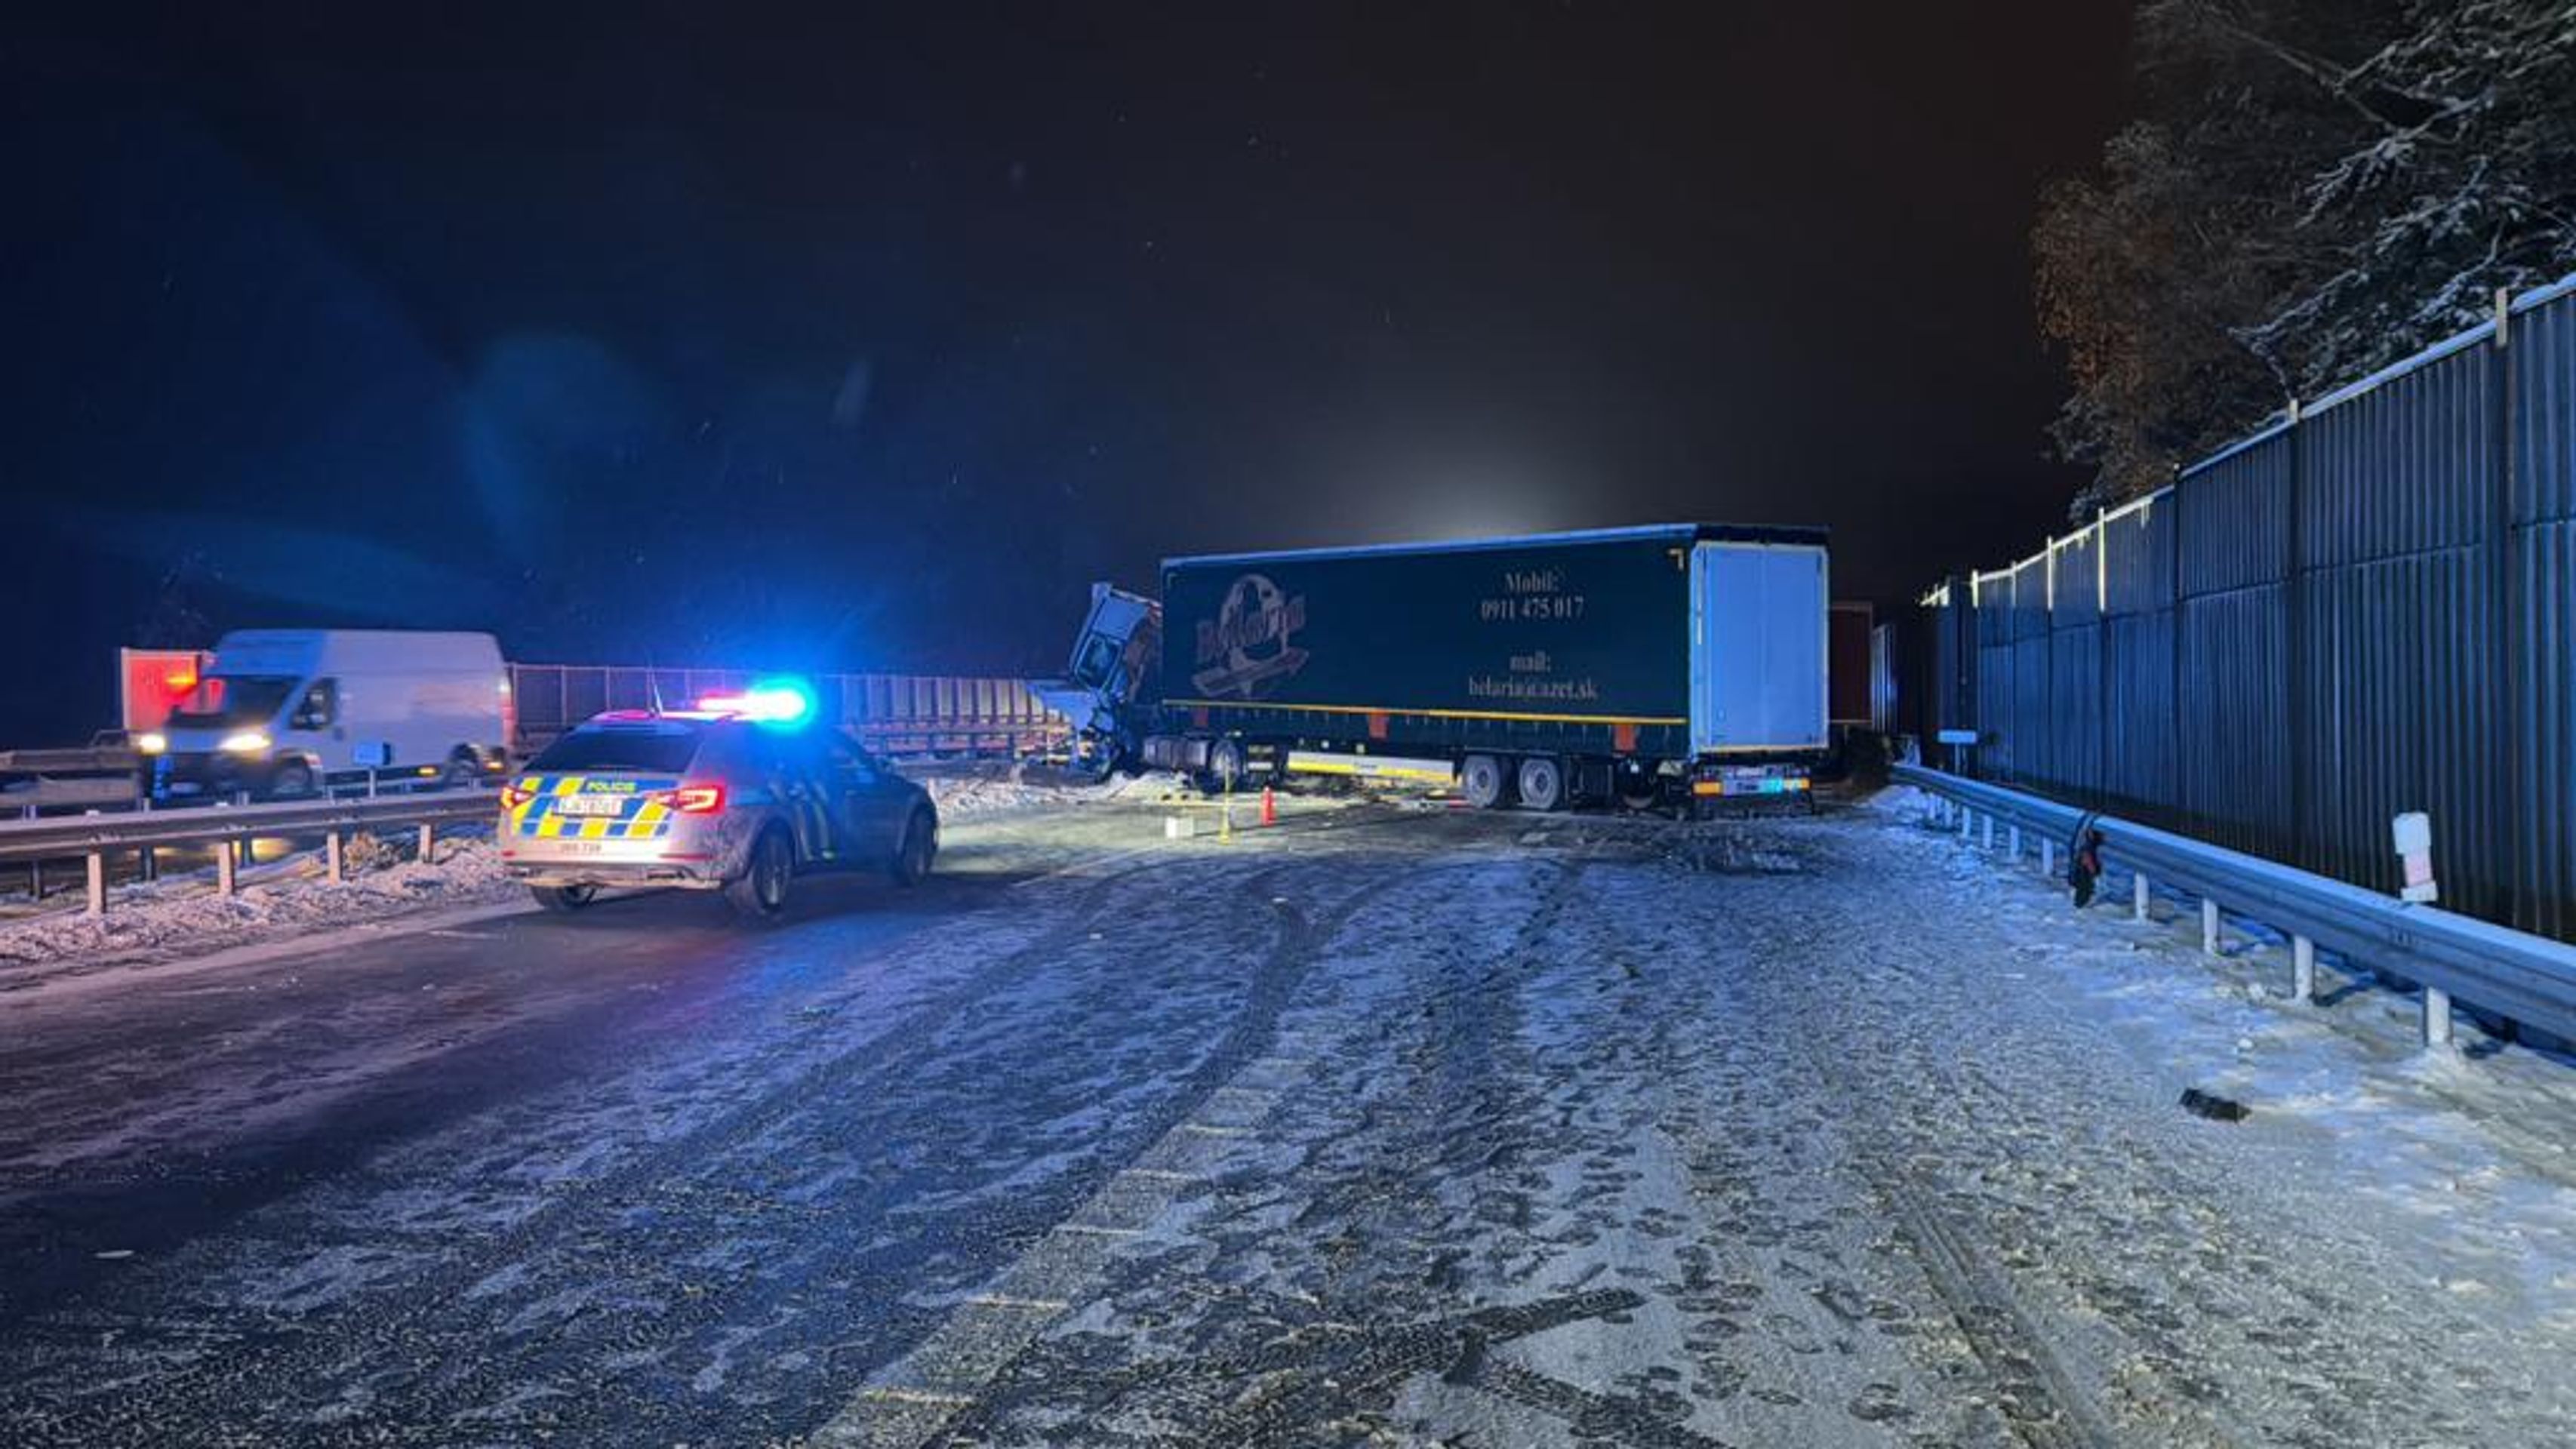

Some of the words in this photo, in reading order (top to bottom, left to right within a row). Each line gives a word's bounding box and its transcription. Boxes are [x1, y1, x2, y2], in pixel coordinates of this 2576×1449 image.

[1507, 571, 1559, 592] Mobil:
[1481, 598, 1516, 620] 0911
[1522, 597, 1550, 619] 475
[1554, 595, 1584, 617] 017
[1510, 651, 1551, 672] mail:
